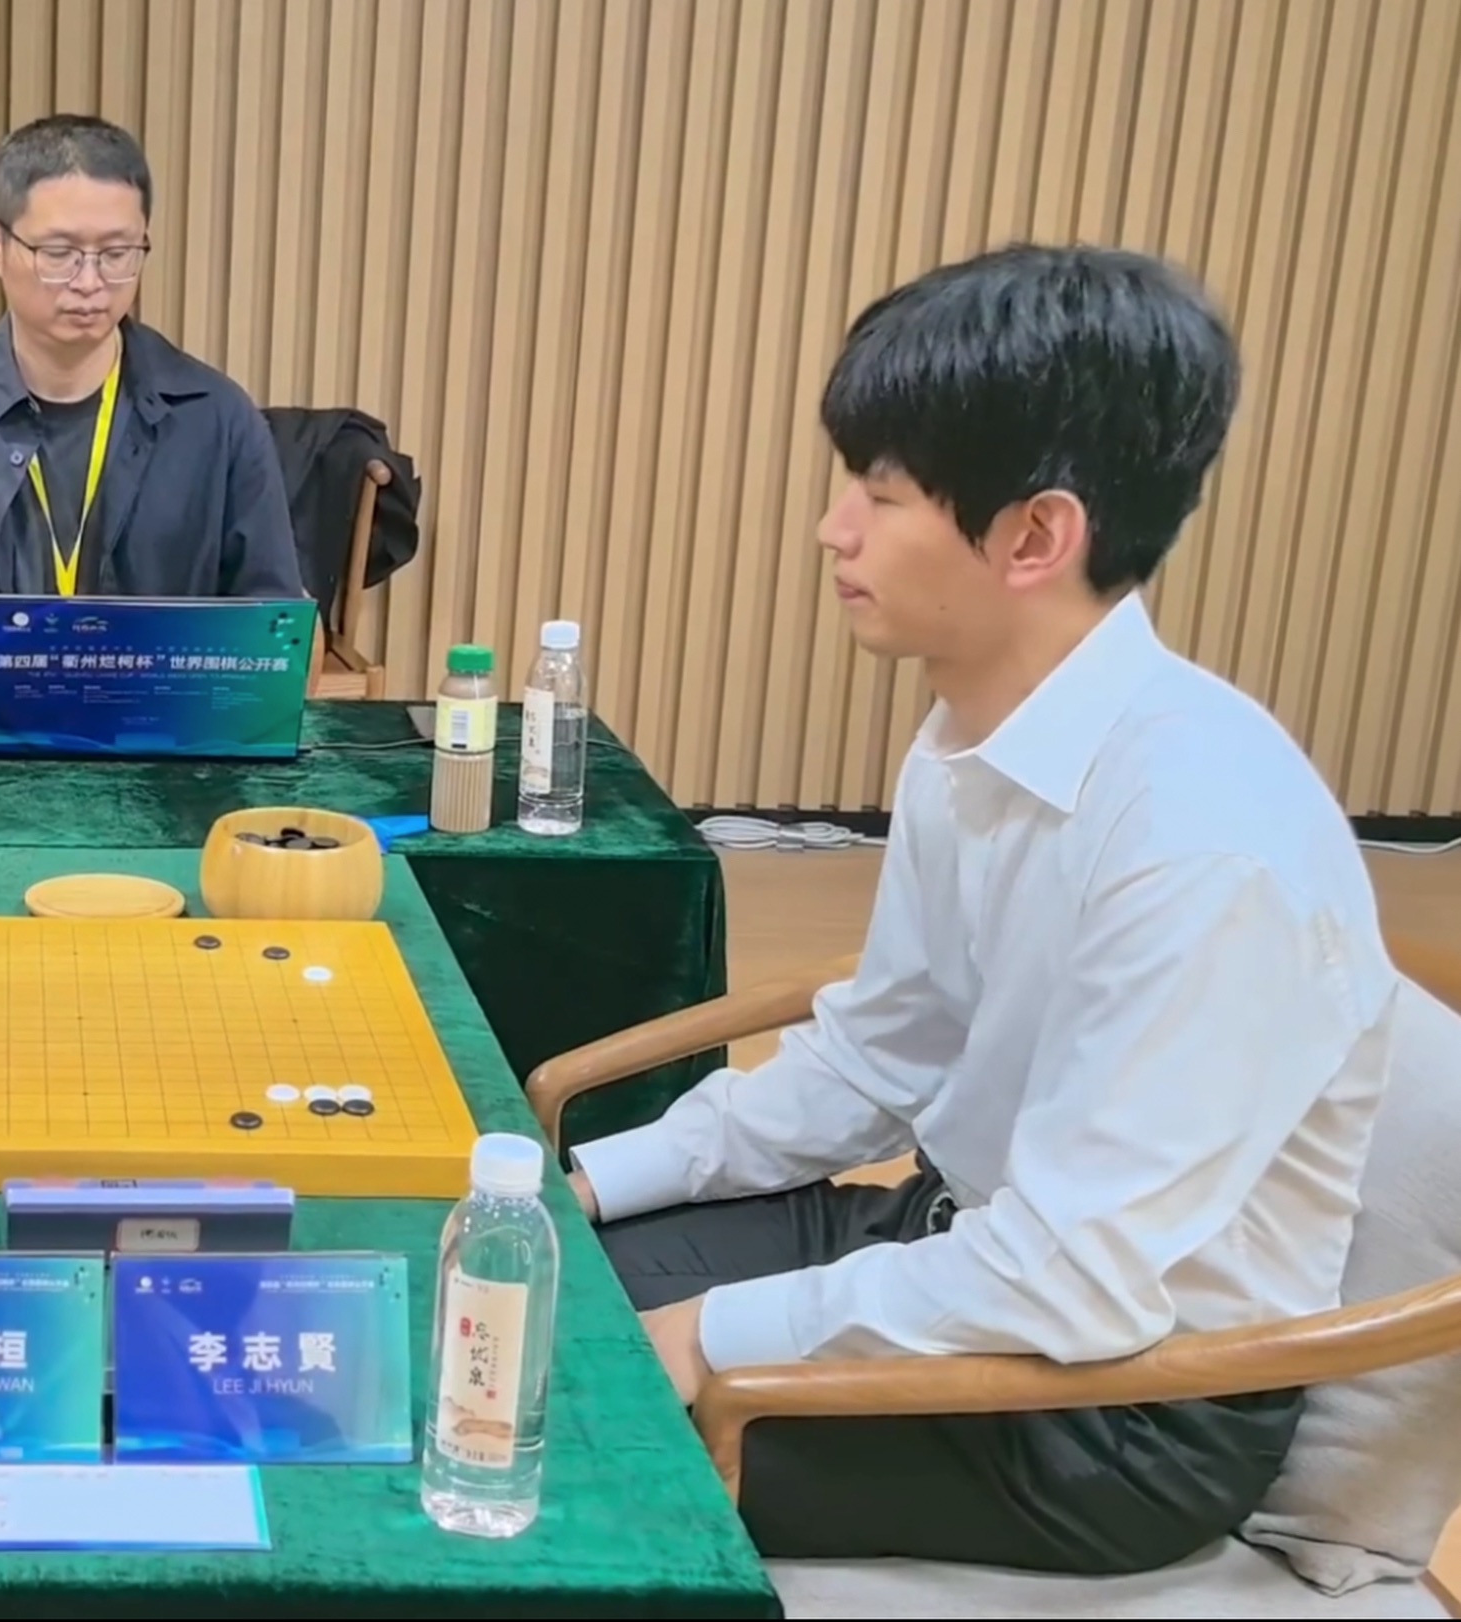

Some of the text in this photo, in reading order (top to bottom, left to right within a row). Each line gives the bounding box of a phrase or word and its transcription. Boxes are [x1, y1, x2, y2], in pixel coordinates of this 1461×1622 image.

[188, 1330, 337, 1373] 李志賢
[213, 1378, 314, 1395] LEE JI HYUN
